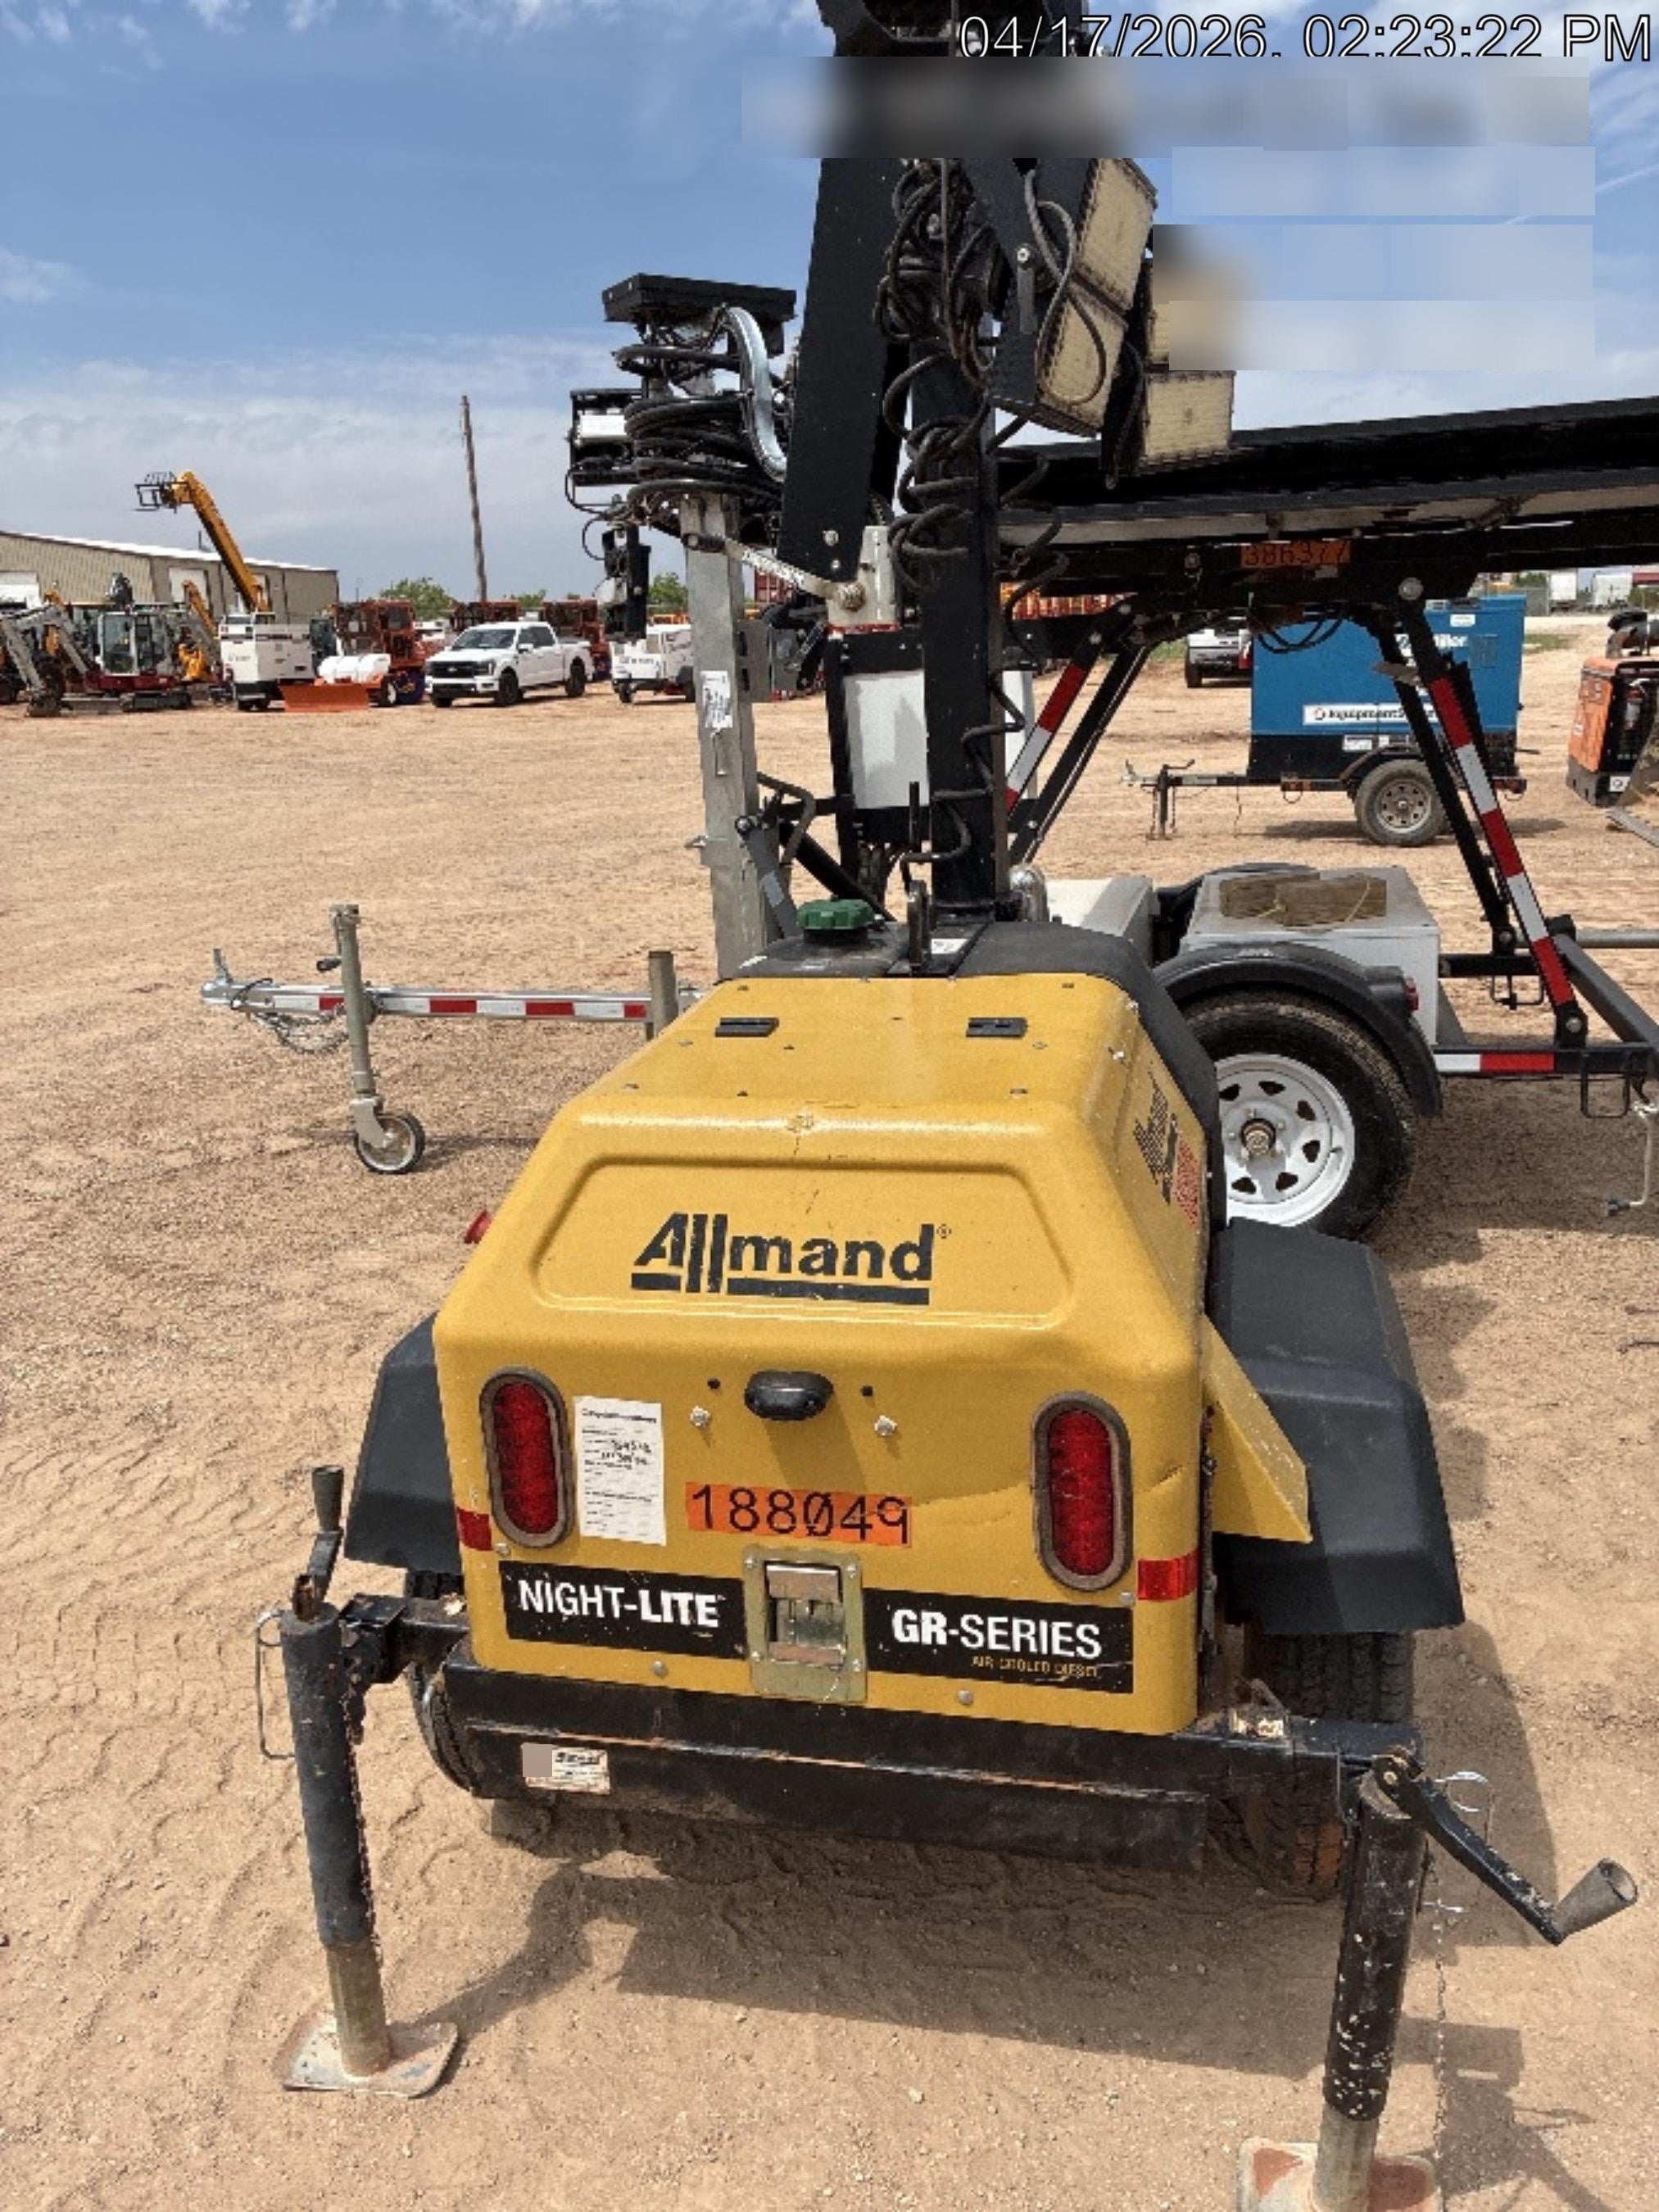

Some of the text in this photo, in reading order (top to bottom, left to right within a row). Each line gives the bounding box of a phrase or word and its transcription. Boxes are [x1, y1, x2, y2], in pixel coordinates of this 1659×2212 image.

[692, 1484, 908, 1544] 188049
[518, 1580, 719, 1628] NIGHT-LITE
[892, 1608, 1102, 1660] GR-SERIES
